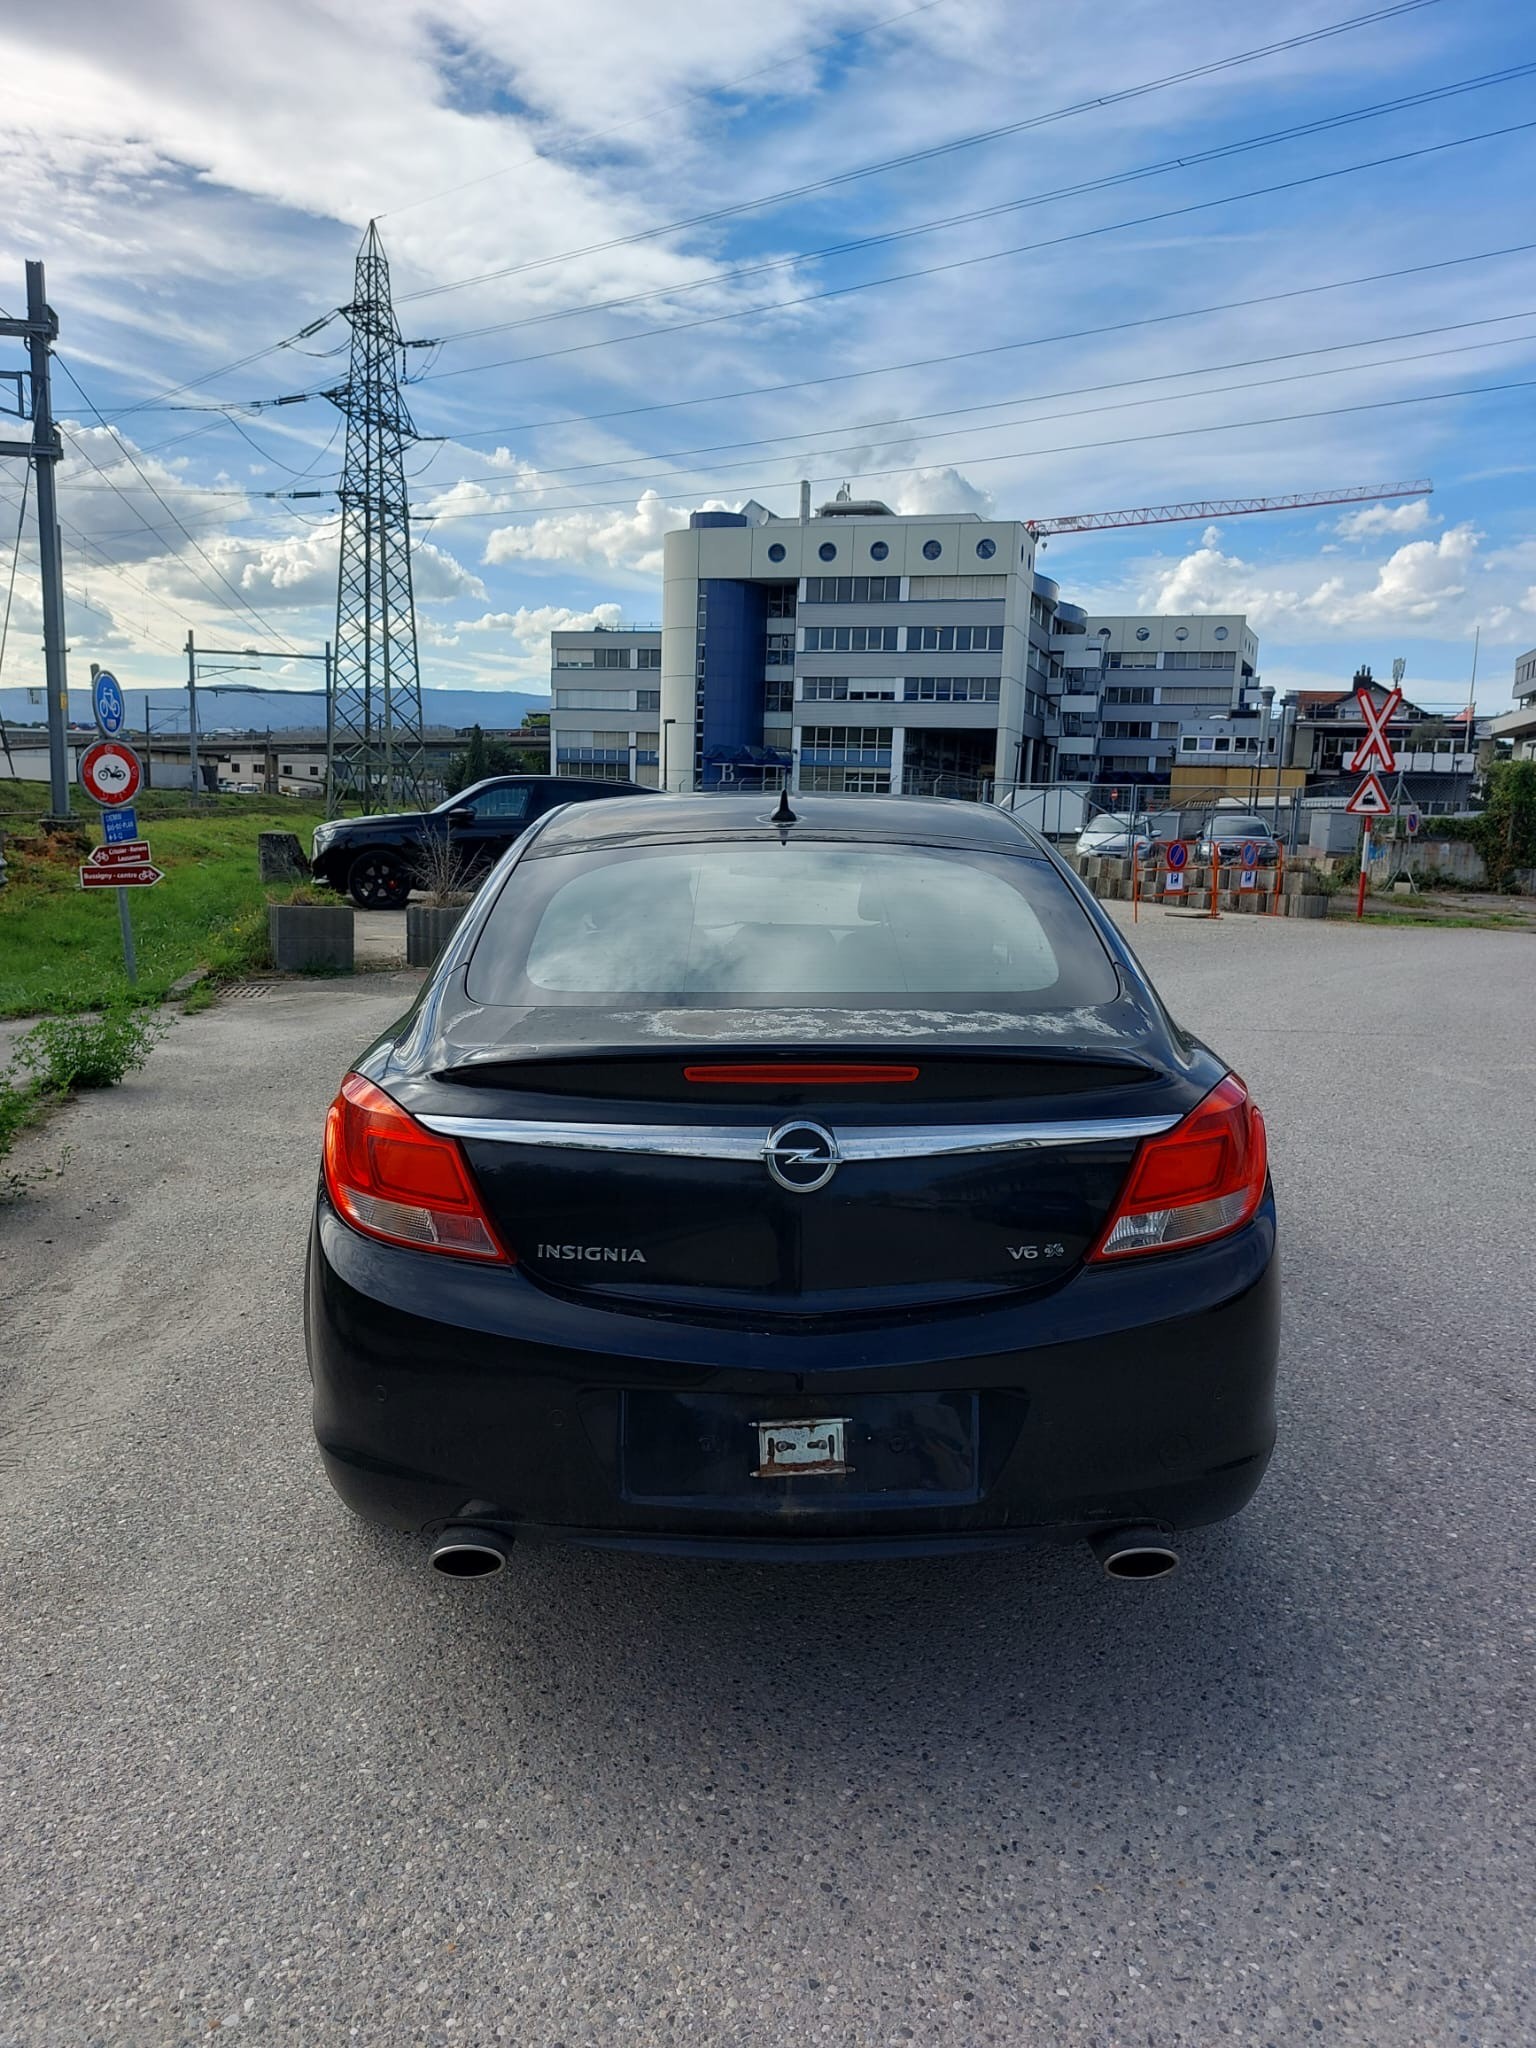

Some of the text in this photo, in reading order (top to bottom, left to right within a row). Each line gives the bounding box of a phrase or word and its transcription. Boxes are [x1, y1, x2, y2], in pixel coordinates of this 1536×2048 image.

[84, 872, 112, 880] Bussigny
[537, 1244, 647, 1263] INSIGNIA
[1007, 1245, 1038, 1260] V6
